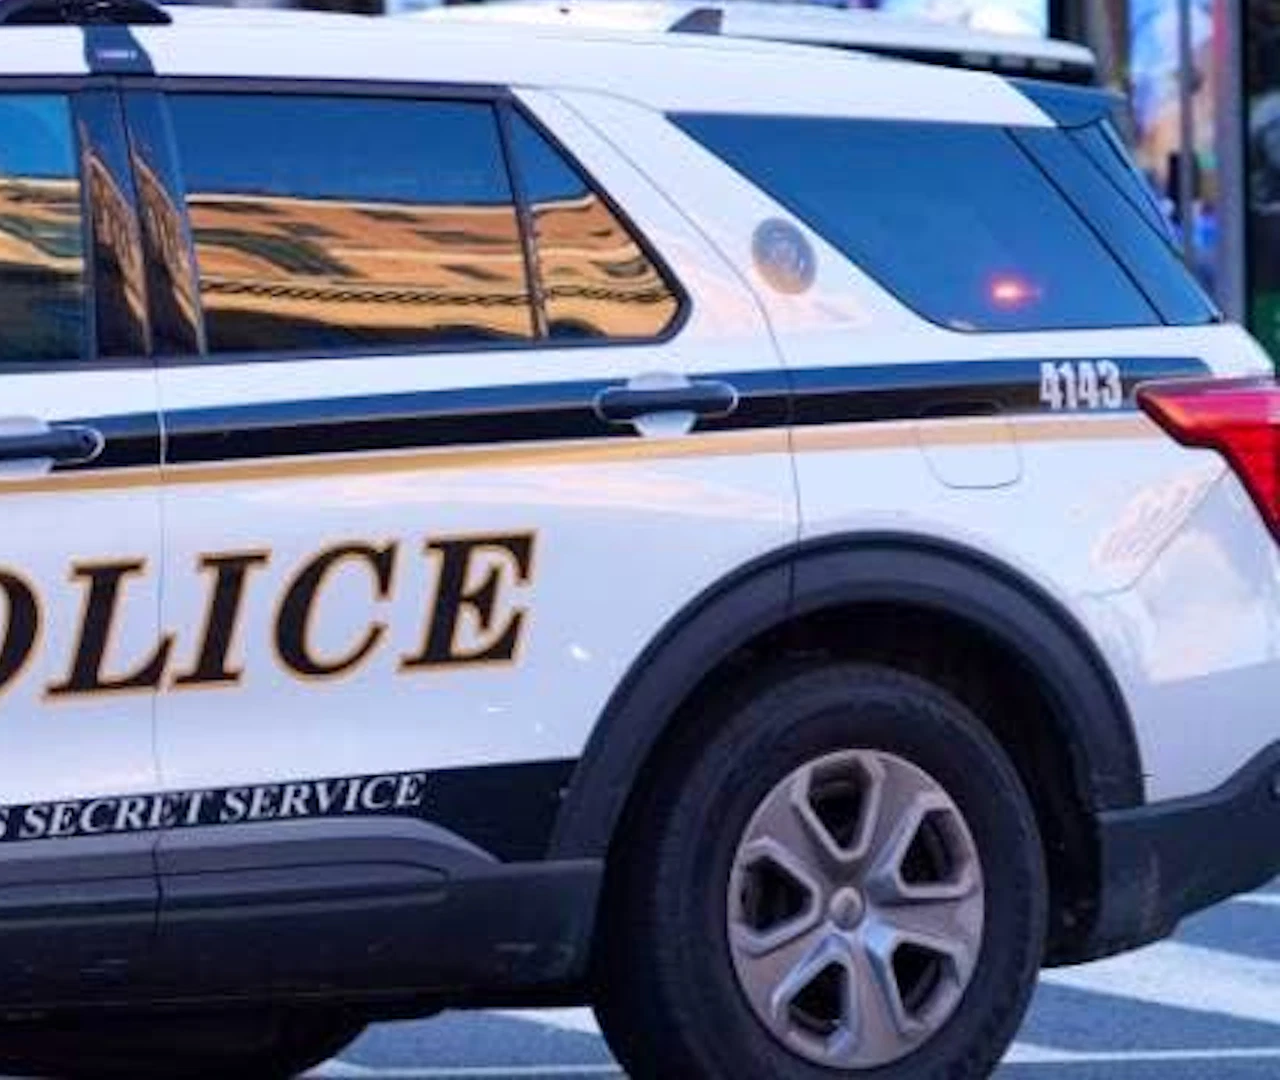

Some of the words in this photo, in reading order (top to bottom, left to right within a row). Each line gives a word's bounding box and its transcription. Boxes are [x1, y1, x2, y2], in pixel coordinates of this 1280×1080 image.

[1040, 360, 1123, 410] 4143
[18, 788, 215, 836] SECRET
[220, 773, 425, 822] SERVICE
